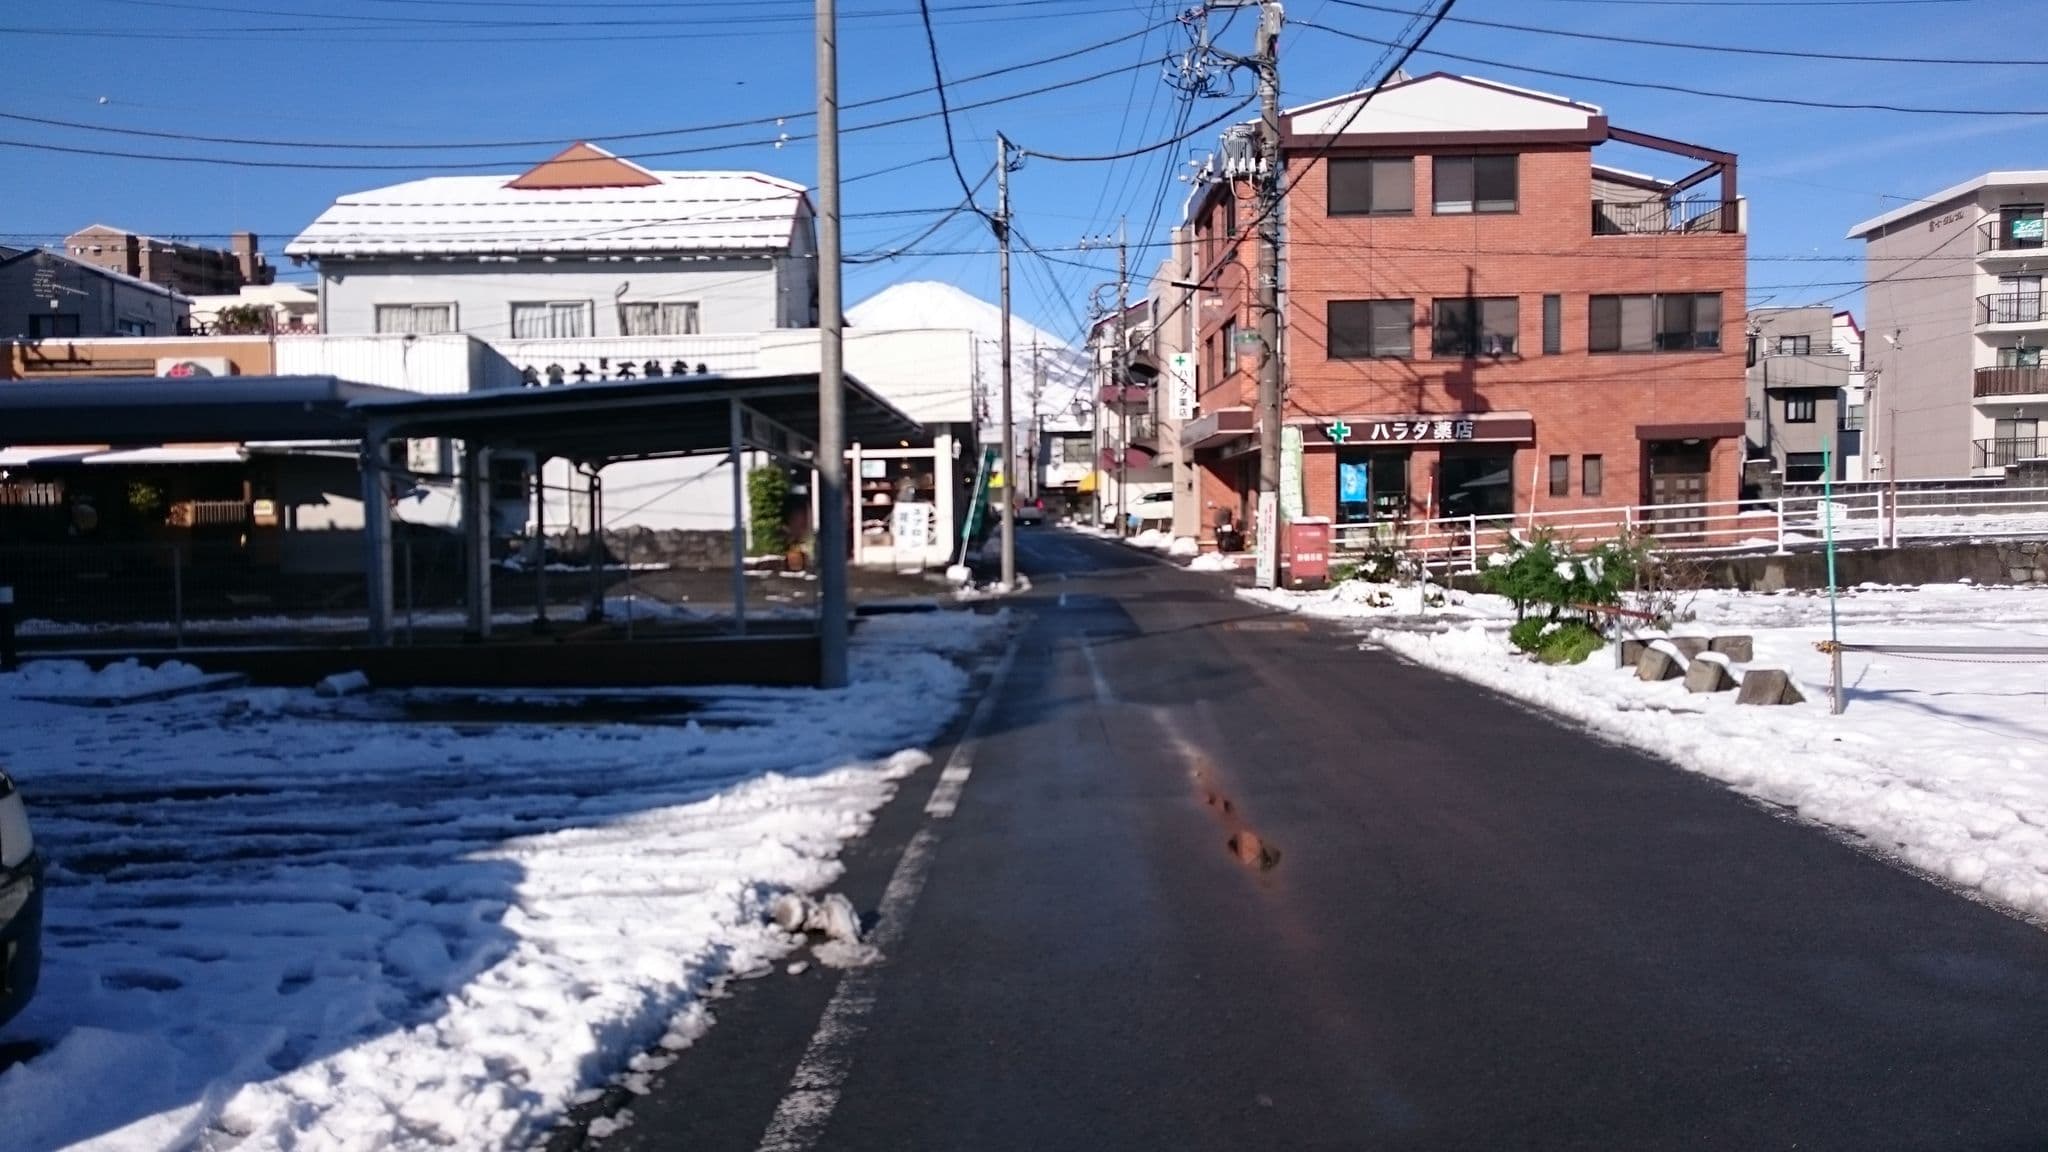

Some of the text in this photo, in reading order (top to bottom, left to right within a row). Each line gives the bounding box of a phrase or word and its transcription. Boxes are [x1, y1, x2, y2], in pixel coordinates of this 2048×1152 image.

[1371, 421, 1474, 440] ハラダ薬店
